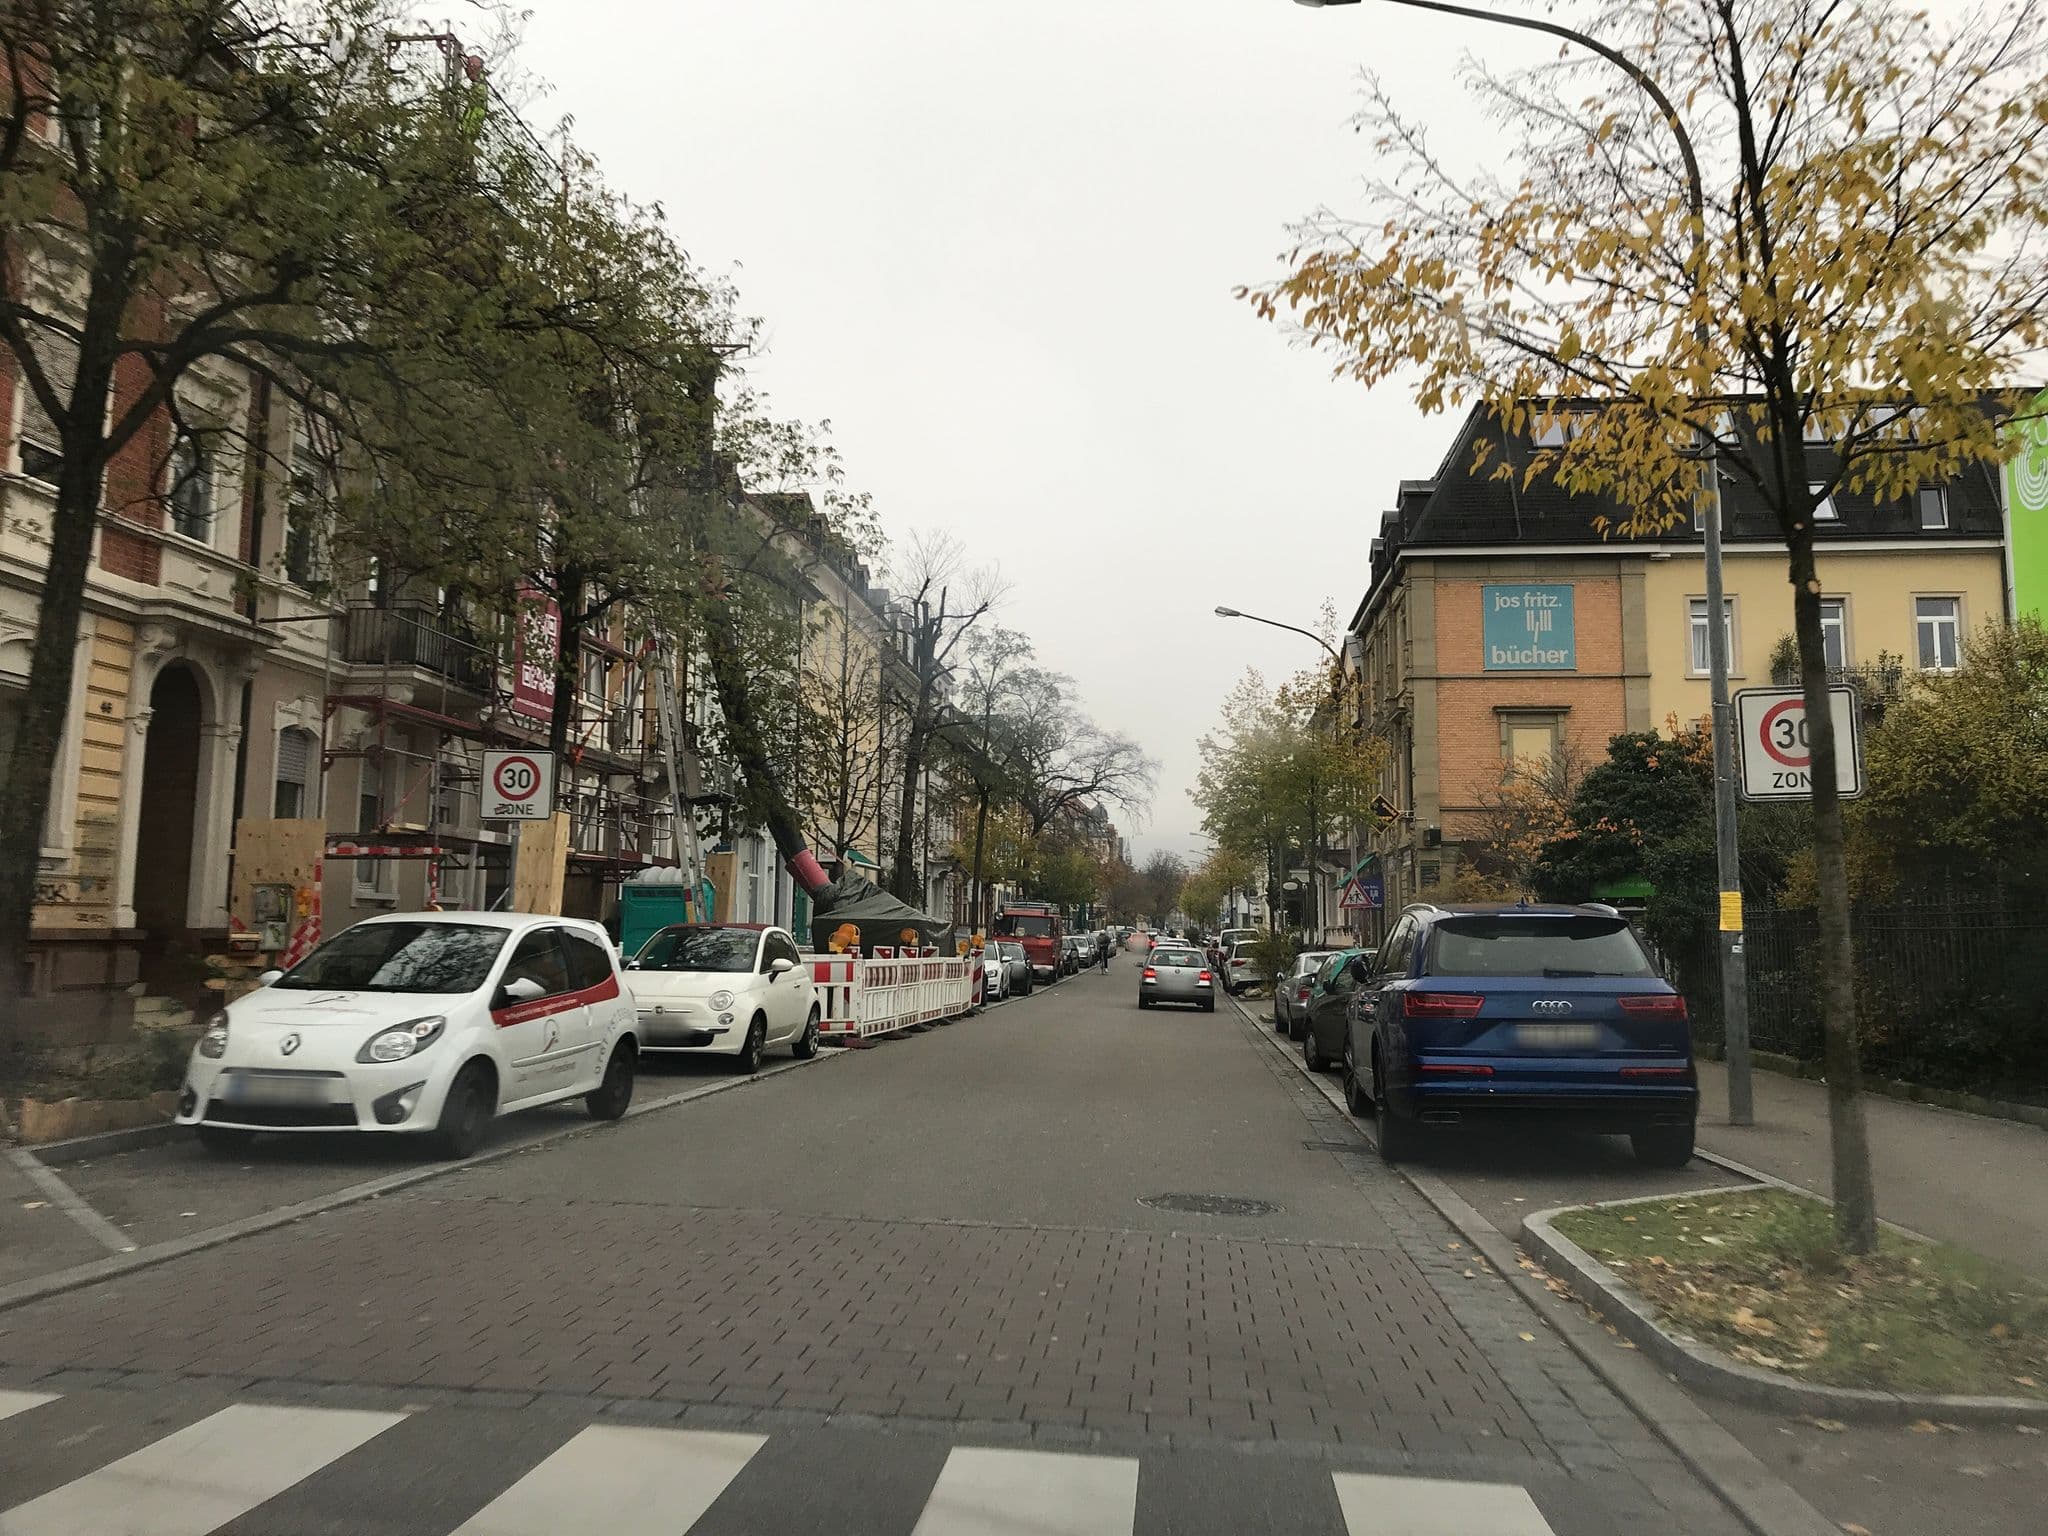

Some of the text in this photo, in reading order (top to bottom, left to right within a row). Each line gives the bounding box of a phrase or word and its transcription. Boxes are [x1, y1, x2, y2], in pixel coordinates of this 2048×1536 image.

[1494, 591, 1562, 612] jos fritz.
[1491, 645, 1569, 665] bücher
[503, 768, 531, 789] 30
[1772, 772, 1812, 789] ZON
